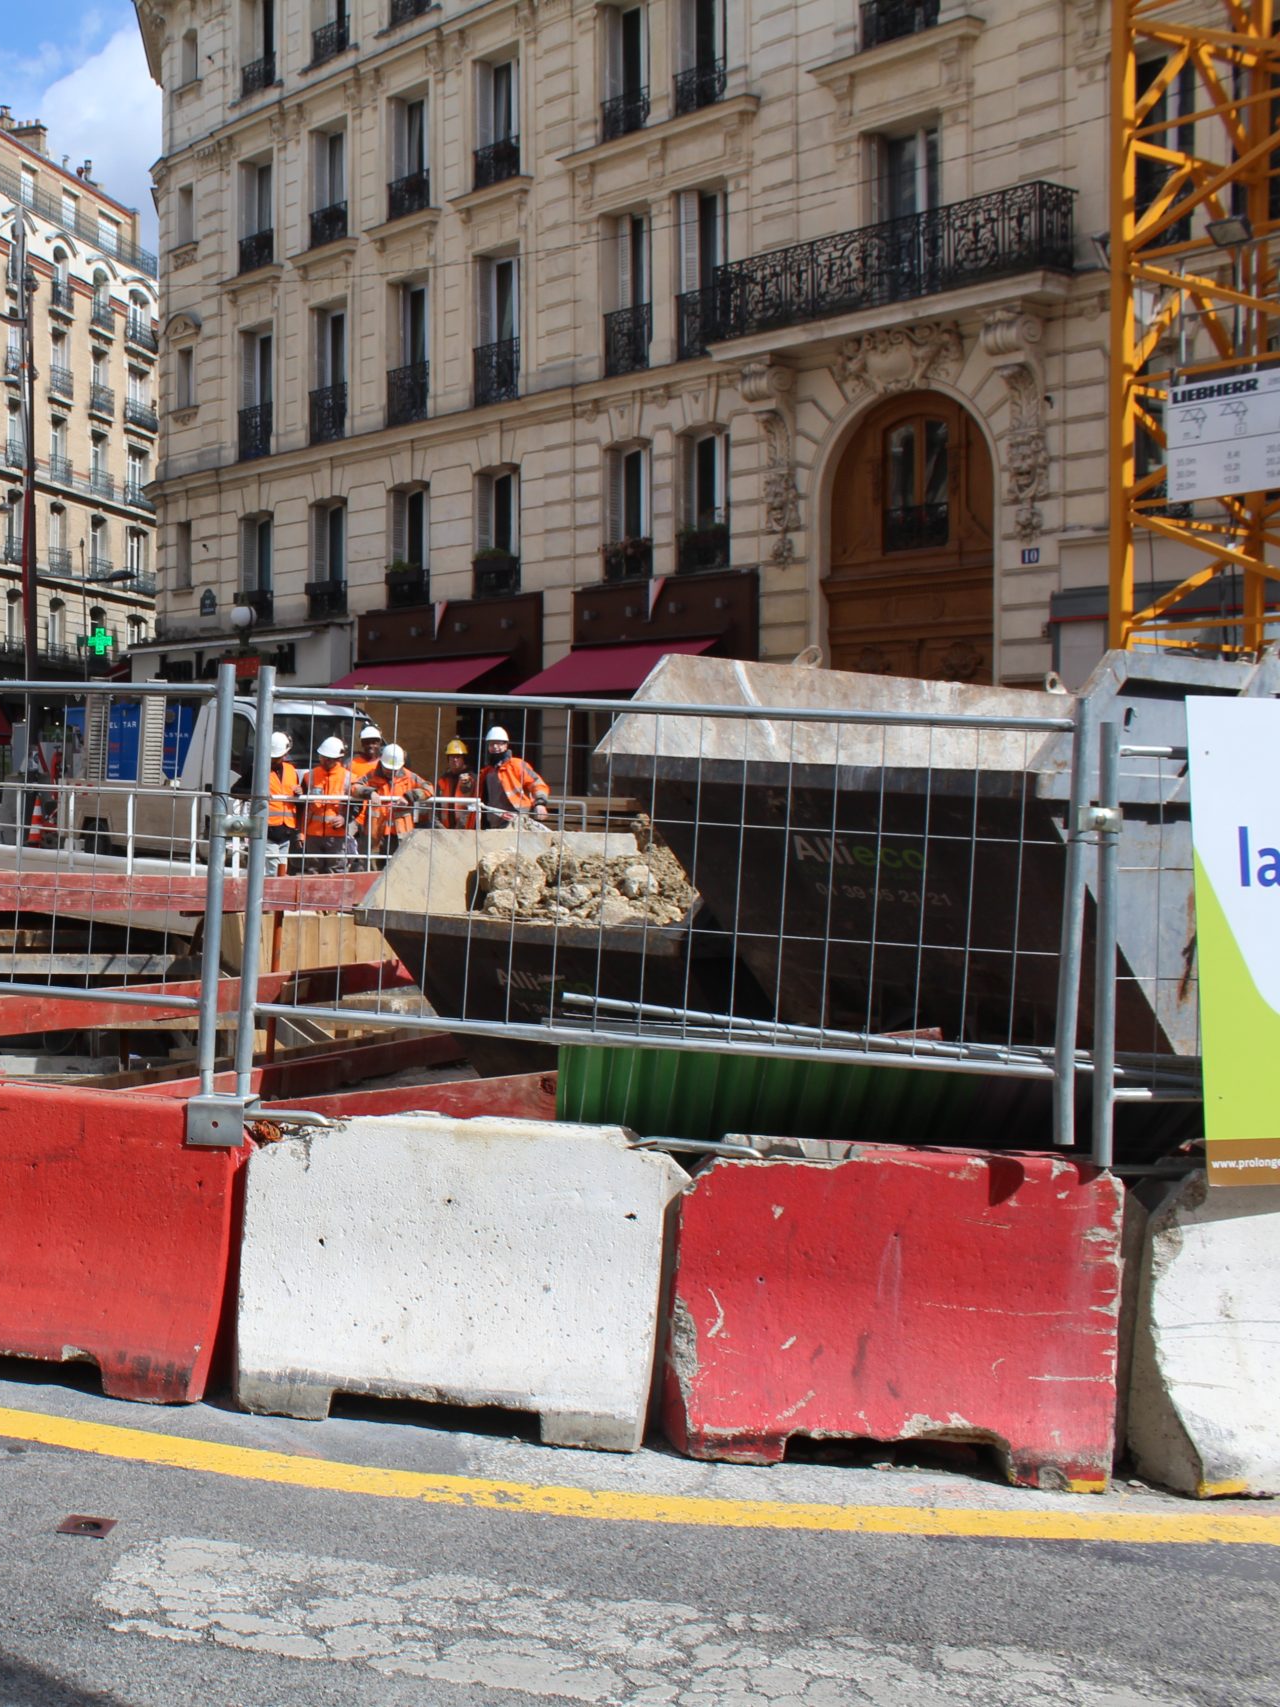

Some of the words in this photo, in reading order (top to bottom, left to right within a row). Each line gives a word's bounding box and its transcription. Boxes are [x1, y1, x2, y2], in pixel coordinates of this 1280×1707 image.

[1172, 378, 1258, 404] LIEBHERR
[1024, 549, 1038, 563] 10
[793, 835, 927, 869] Allieco
[1238, 826, 1280, 887] la
[927, 892, 952, 906] 21
